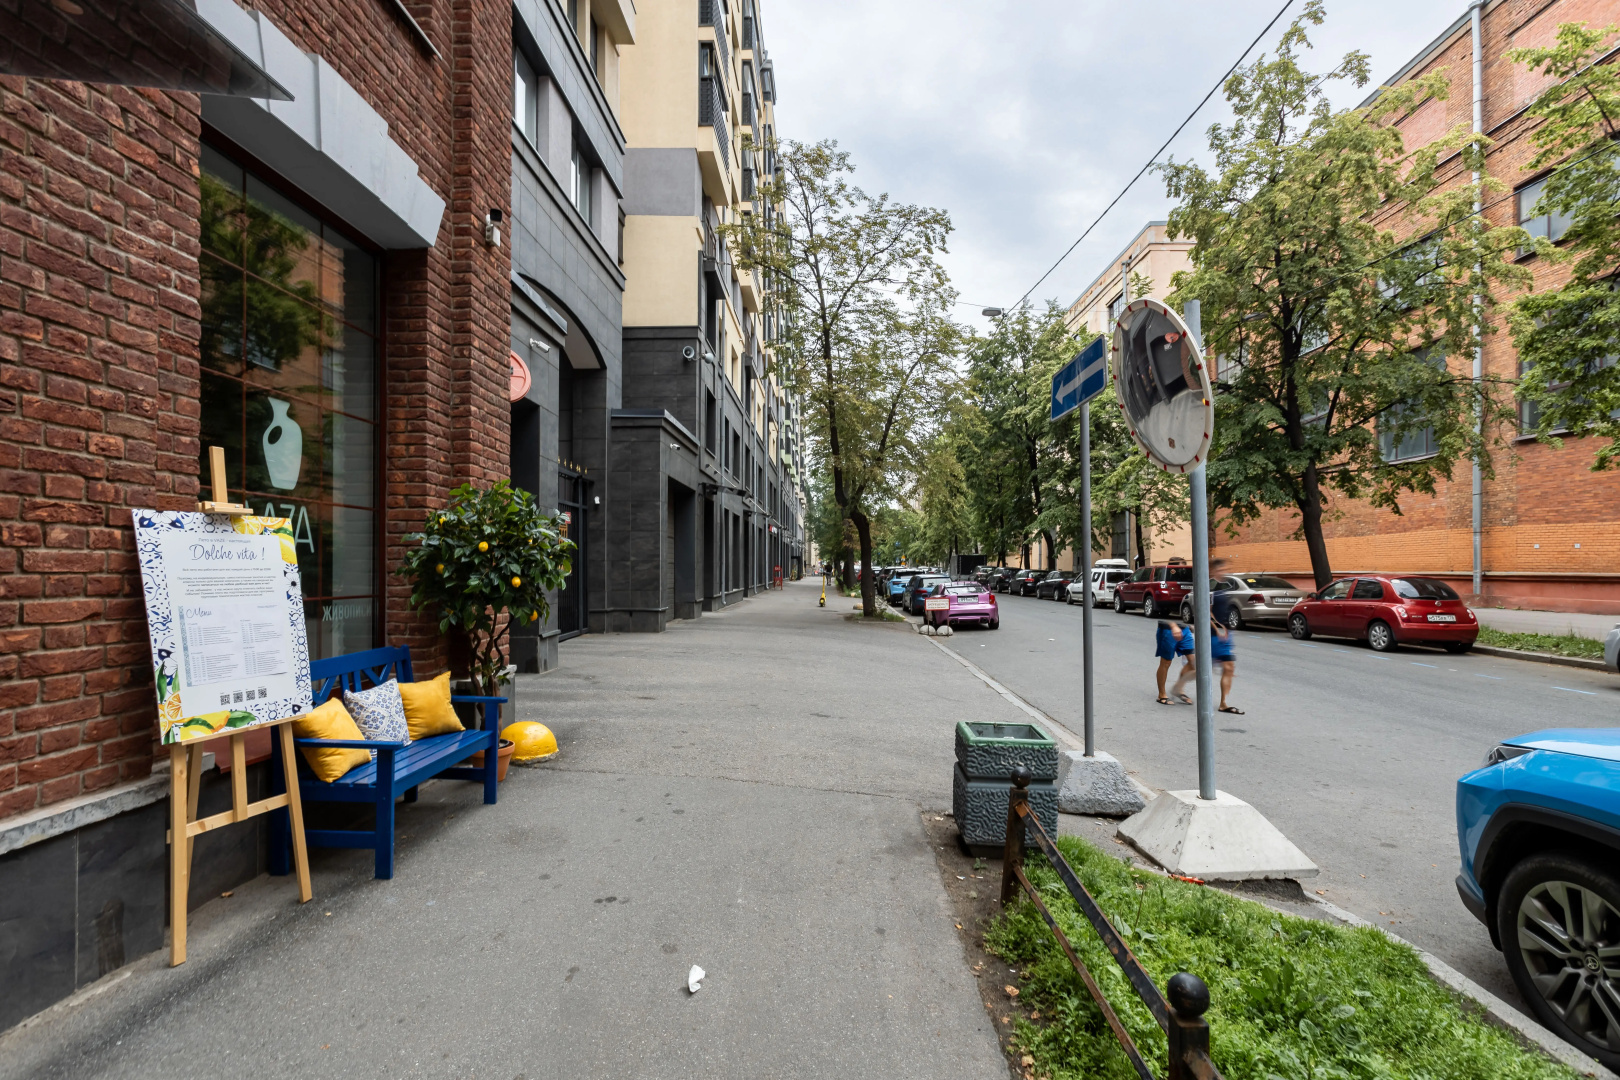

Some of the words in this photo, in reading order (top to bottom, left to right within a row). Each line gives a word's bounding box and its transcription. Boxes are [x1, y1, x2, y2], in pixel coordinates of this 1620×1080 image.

[189, 544, 233, 561] Dolche
[236, 546, 258, 561] vita
[261, 546, 265, 560] !
